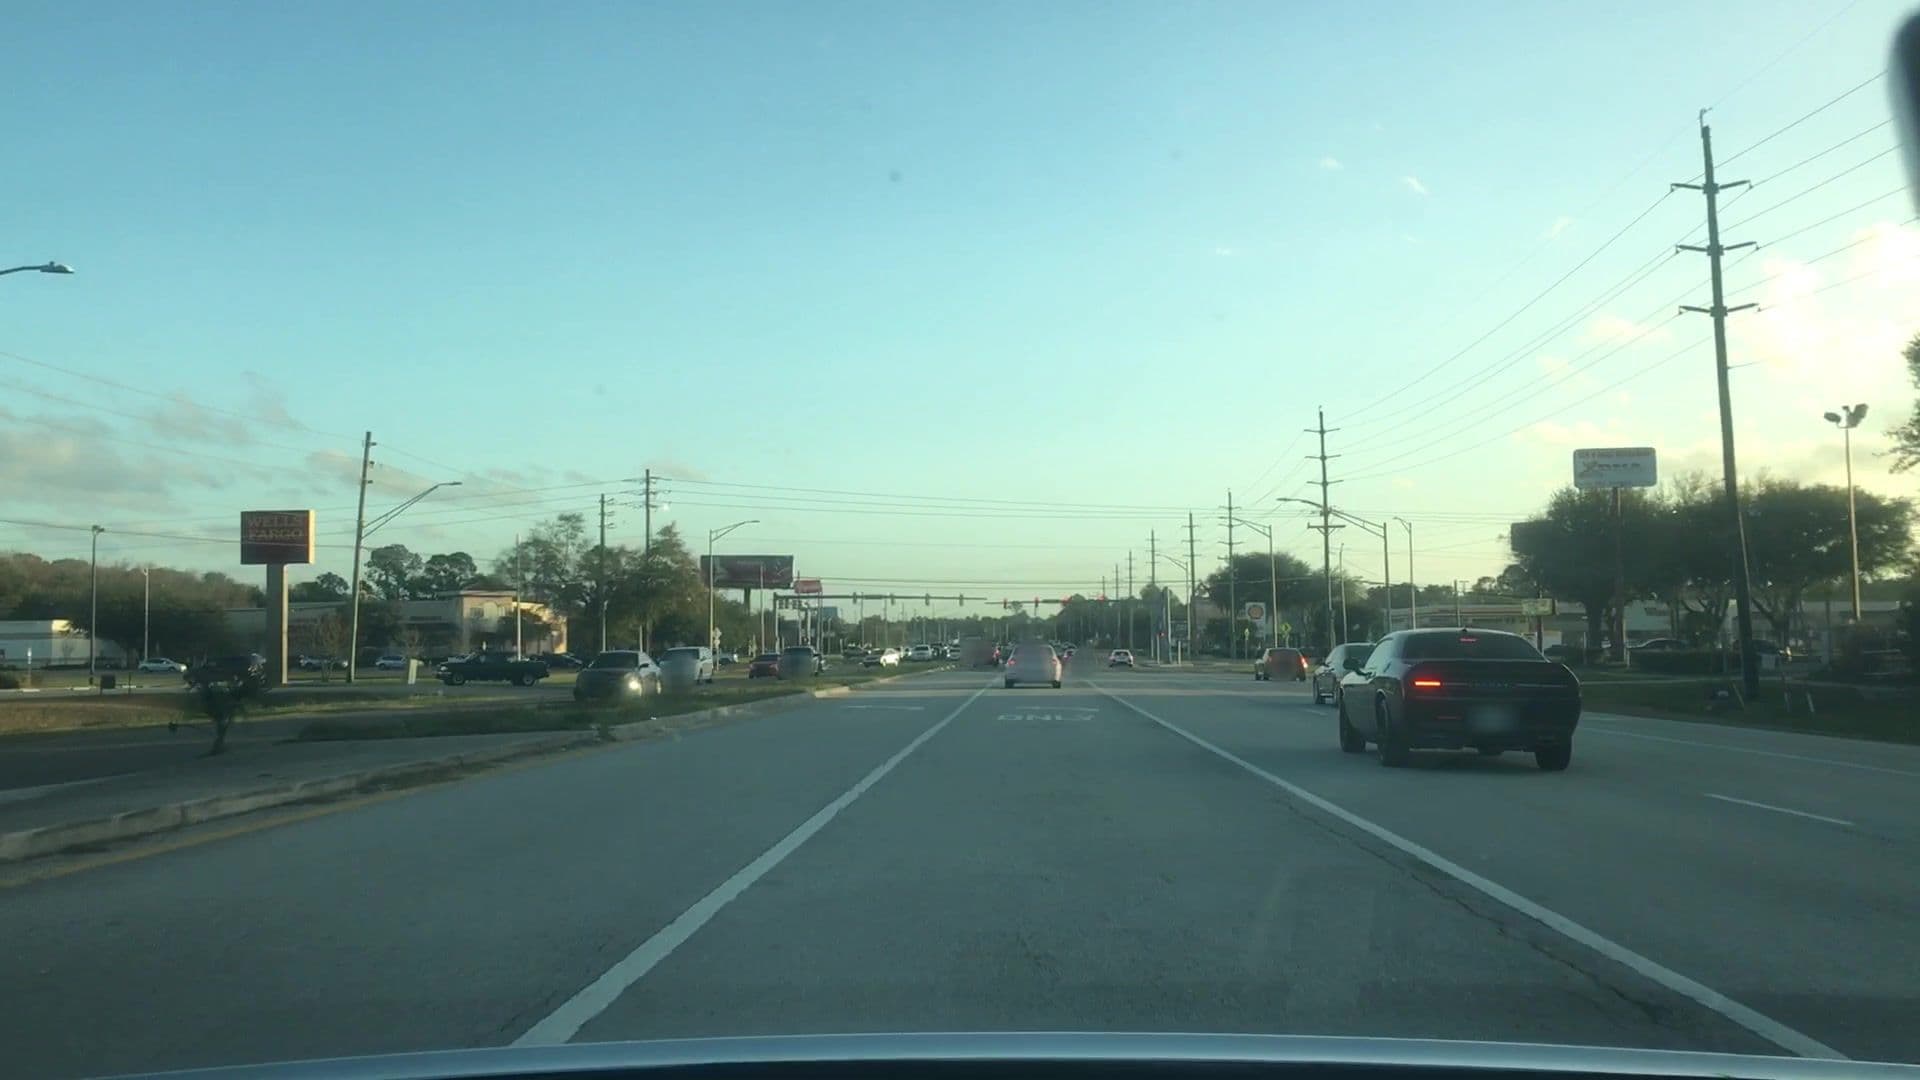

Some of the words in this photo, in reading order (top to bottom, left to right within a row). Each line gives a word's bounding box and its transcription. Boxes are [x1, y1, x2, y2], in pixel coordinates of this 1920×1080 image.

[247, 514, 303, 527] WELLS
[247, 527, 304, 539] FARGO
[997, 712, 1097, 721] ONLY
